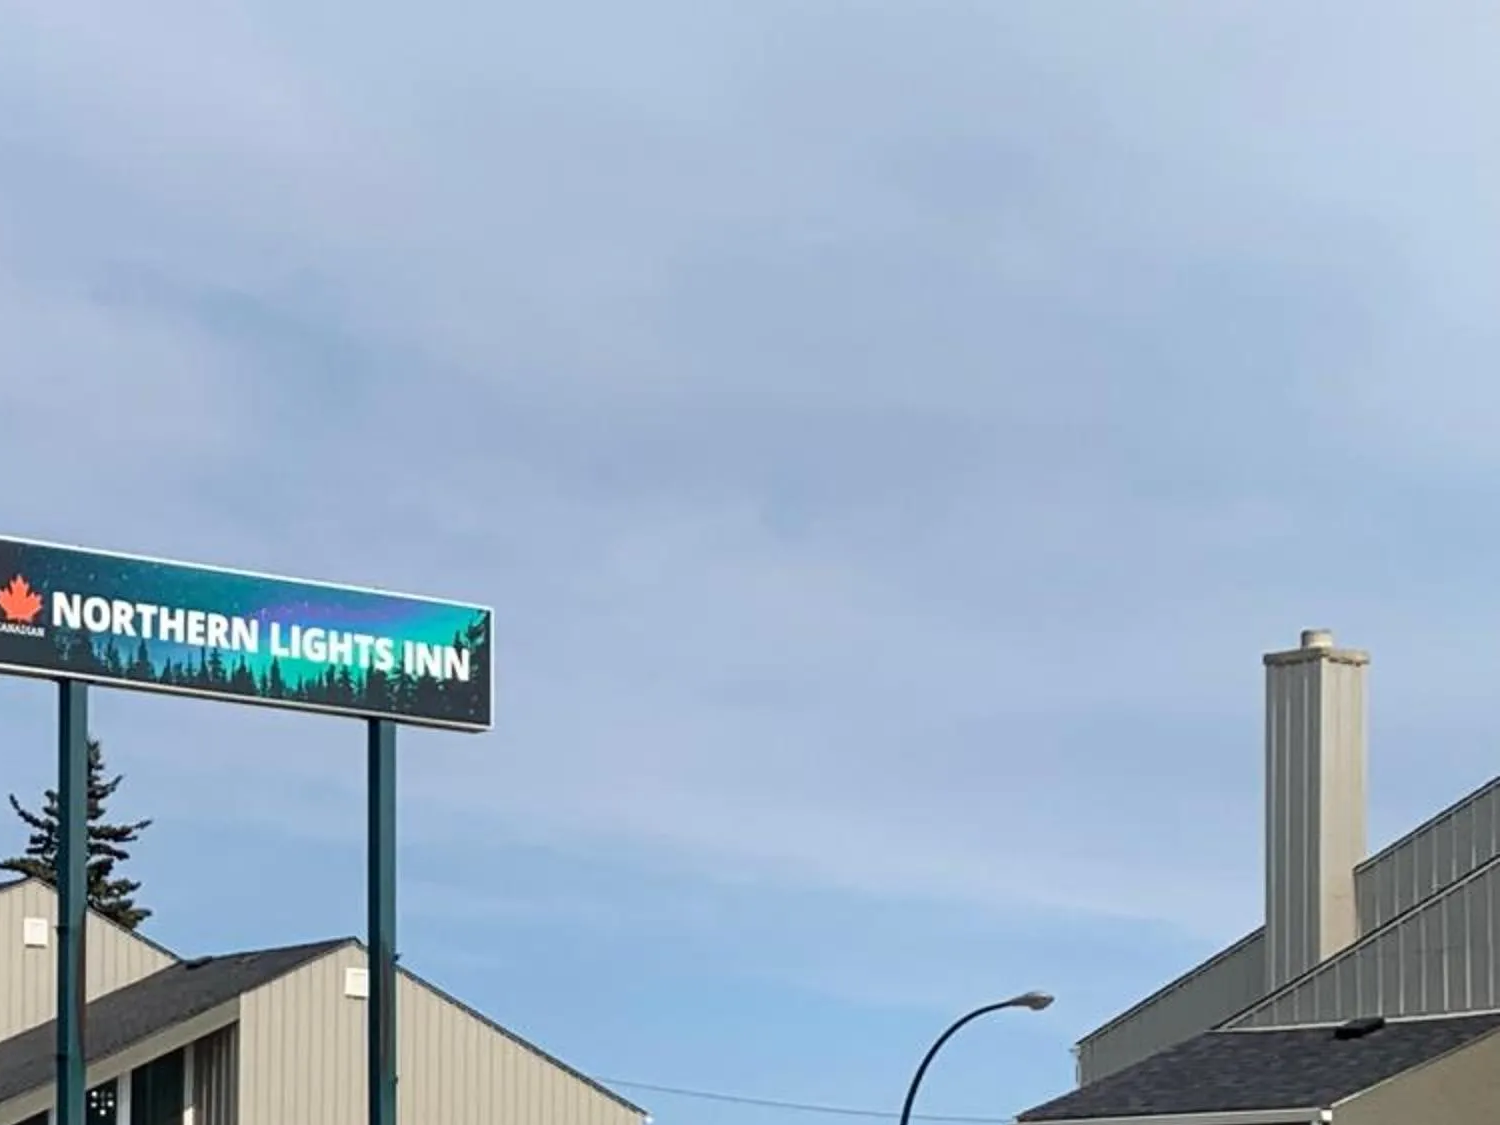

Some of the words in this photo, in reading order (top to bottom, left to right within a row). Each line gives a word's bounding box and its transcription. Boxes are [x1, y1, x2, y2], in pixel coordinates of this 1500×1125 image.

[53, 591, 258, 653] NORTHERN
[270, 623, 394, 670] LIGHTS
[404, 640, 471, 682] INN
